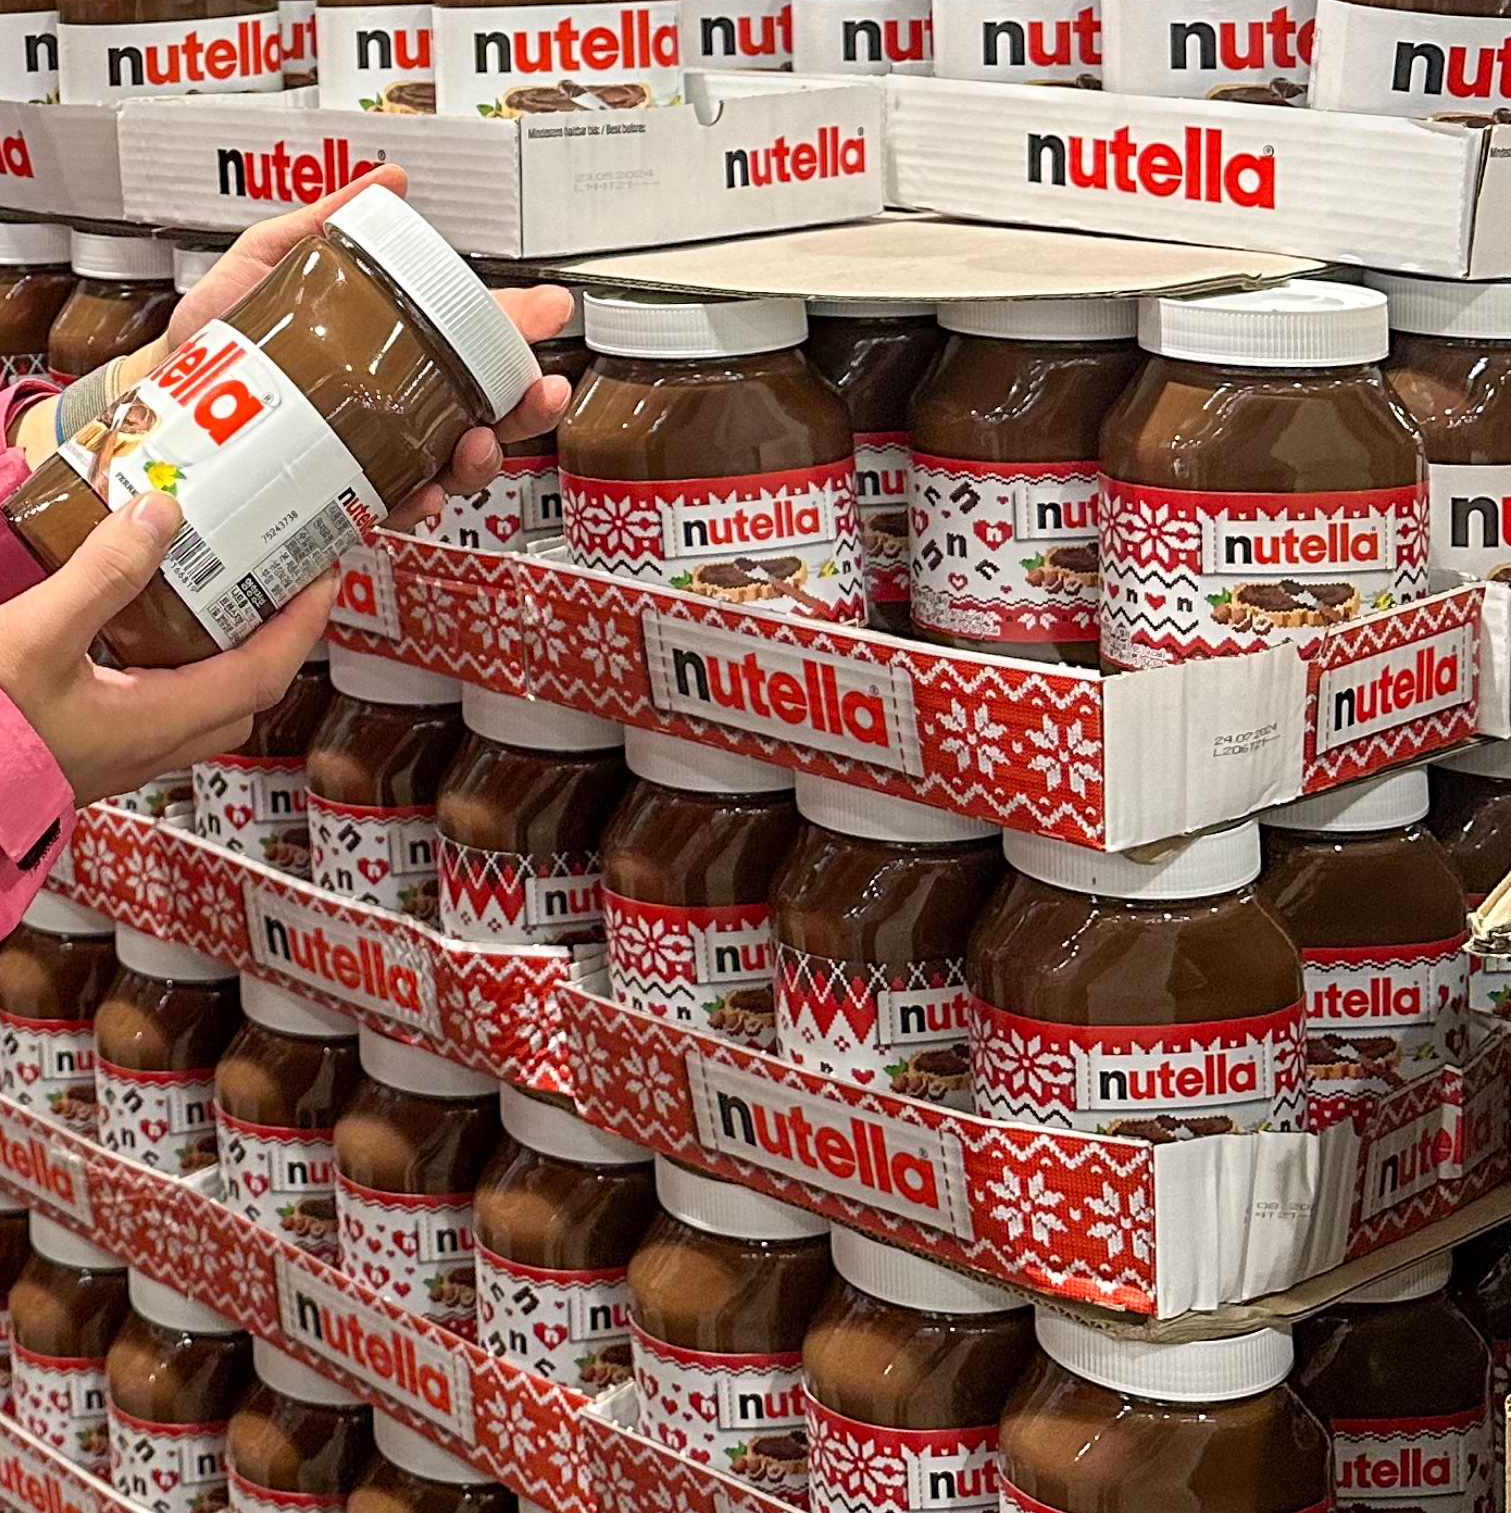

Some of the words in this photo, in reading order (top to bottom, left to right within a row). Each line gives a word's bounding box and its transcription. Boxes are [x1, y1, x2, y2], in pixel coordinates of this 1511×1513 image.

[474, 9, 679, 75] nutella
[725, 126, 866, 190] nutella
[1027, 125, 1276, 210] nutella
[682, 500, 821, 547] nutella
[1224, 523, 1379, 565] nutella
[672, 647, 889, 749] nutella
[1333, 651, 1458, 732] nutella
[263, 912, 421, 1012] nutella
[1099, 1053, 1258, 1101] nutella
[717, 1090, 939, 1211] nutella
[296, 1290, 452, 1416] nutella
